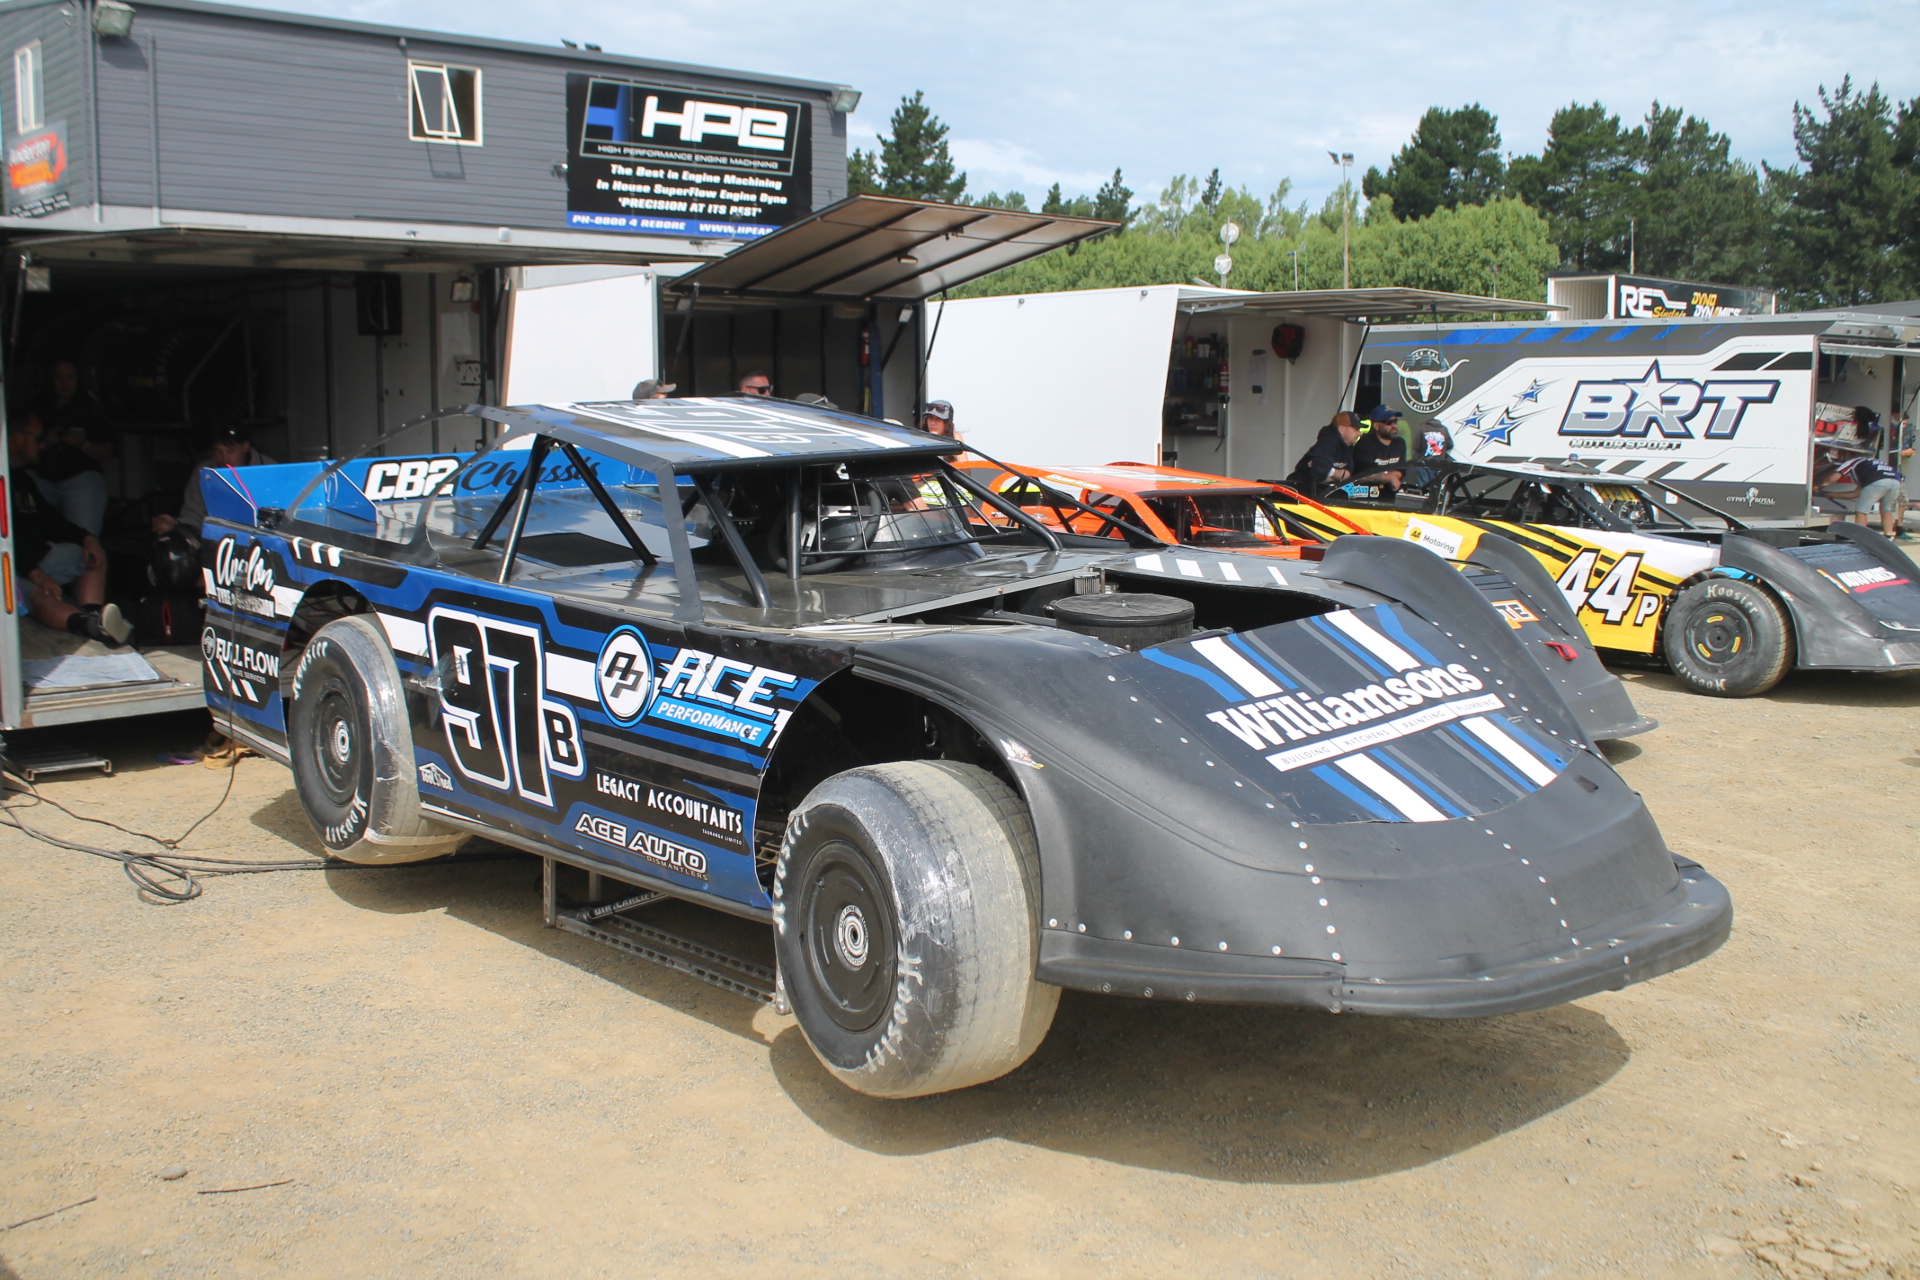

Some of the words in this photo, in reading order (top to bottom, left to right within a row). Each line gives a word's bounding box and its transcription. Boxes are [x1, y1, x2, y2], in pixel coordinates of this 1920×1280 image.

[641, 95, 788, 151] HPE
[597, 144, 622, 154] HIGH
[624, 147, 693, 161] PERFORMANCE
[695, 155, 728, 165] ENGINE
[730, 157, 778, 169] MACHINING
[596, 179, 609, 190] In
[612, 180, 651, 193] House
[654, 184, 717, 199] SuperFlow
[720, 189, 757, 202] Engine
[760, 193, 787, 205] Dyno
[611, 163, 632, 176] The
[636, 166, 664, 179] Best
[667, 169, 679, 180] in
[682, 171, 721, 184] Engine
[724, 174, 782, 191] Machining
[572, 215, 626, 226] PH-0800
[628, 217, 638, 227] 4
[640, 219, 686, 230] REBORE
[690, 202, 705, 213] AT
[708, 203, 728, 215] ITS
[1691, 292, 1717, 306] DYNO
[1693, 305, 1742, 317] DYNAMICS
[1560, 379, 1780, 438] BRT
[1569, 439, 1682, 451] MOTORSPORT
[363, 457, 460, 500] CB2
[1411, 530, 1421, 539] AA
[1423, 534, 1455, 554] Motoring
[1705, 584, 1758, 614] Hoosier
[243, 647, 280, 678] FLOW
[292, 640, 328, 701] Hoosier
[1675, 661, 1727, 691] Hoosier
[660, 648, 799, 721] ACE
[429, 607, 554, 807] 97
[657, 701, 762, 741] PERFORMANCE
[1206, 663, 1483, 751] Williamsons
[1281, 746, 1330, 765] BUILDING
[1344, 729, 1390, 746] KITCHENS
[1402, 710, 1446, 729] PAINTING
[1455, 698, 1496, 712] PLUMBING
[596, 773, 641, 803] LEGACY
[647, 788, 743, 834] ACCOUNTANTS
[574, 812, 628, 848] ACE
[628, 831, 707, 874] AUTO
[702, 828, 724, 840] TAURANGA
[724, 836, 743, 846] LIMITED
[646, 855, 708, 881] DISMANTLERS
